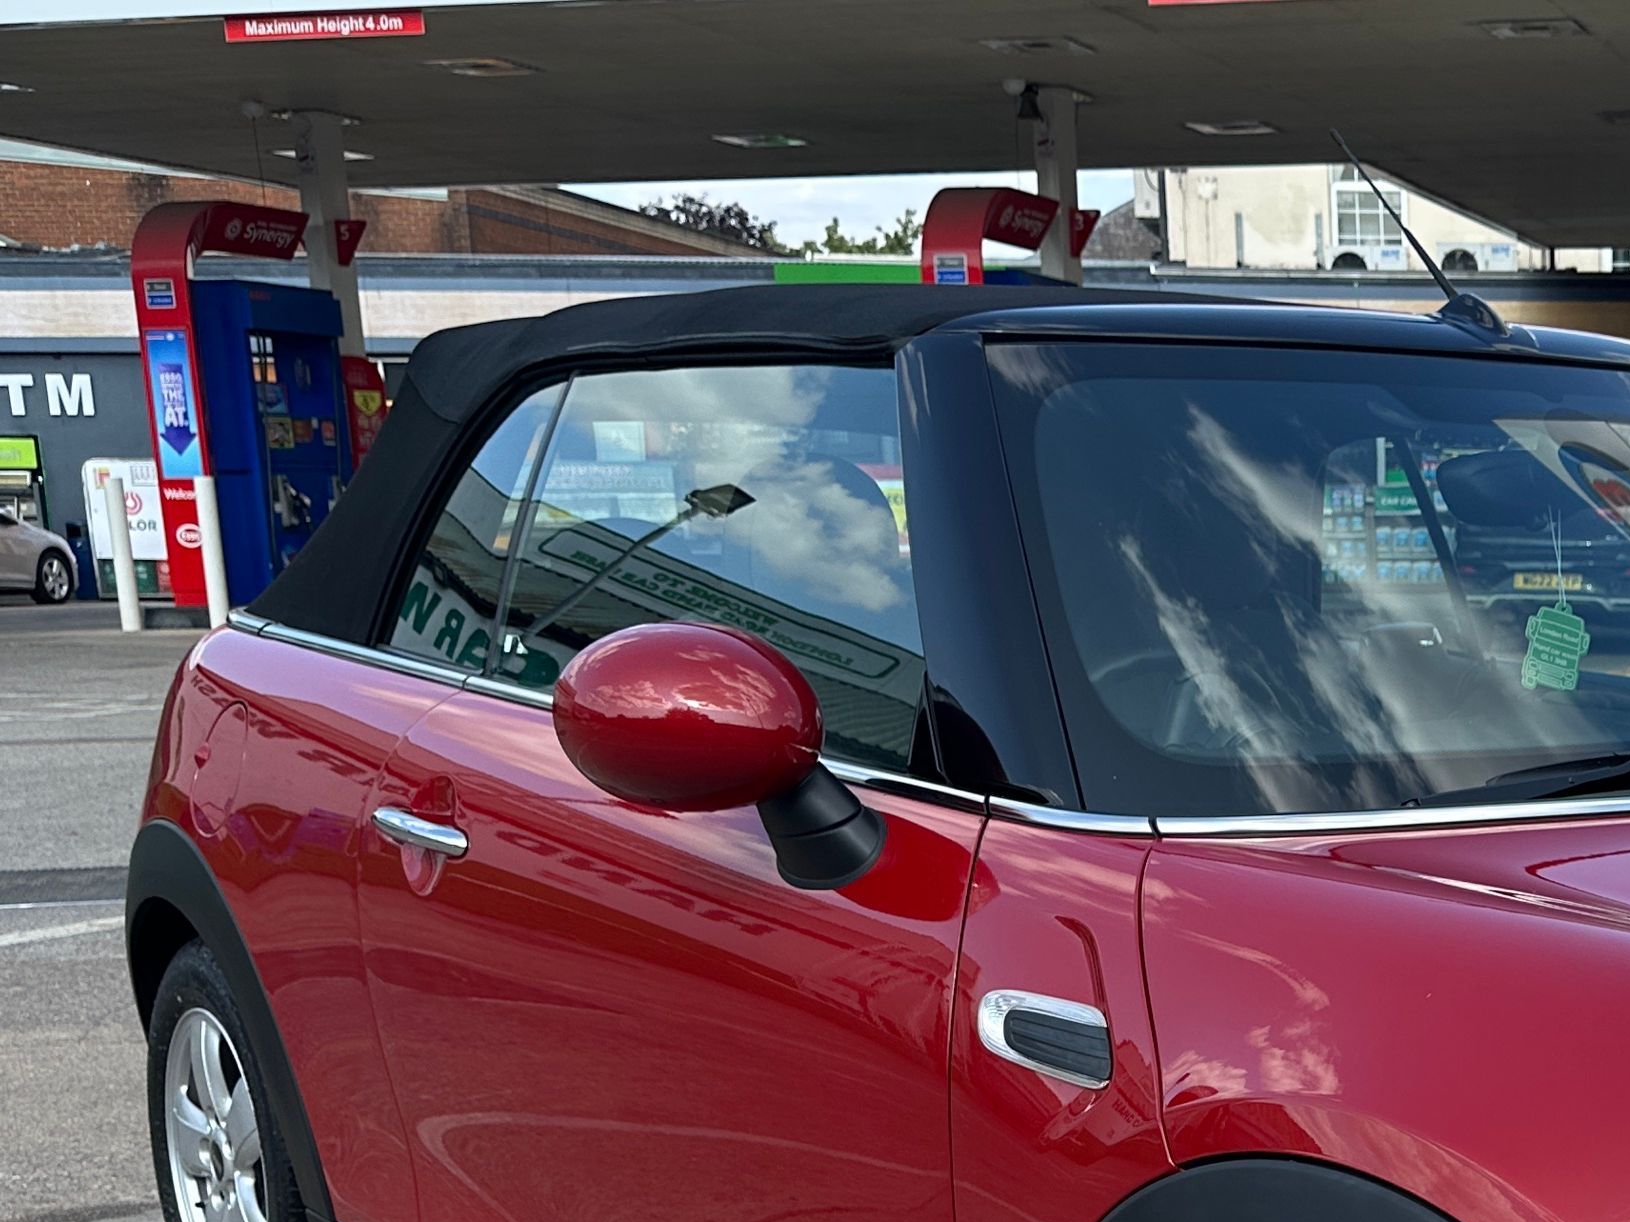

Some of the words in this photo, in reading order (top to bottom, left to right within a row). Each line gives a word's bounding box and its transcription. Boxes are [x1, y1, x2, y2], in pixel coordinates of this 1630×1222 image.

[245, 19, 313, 36] Maximum
[317, 16, 363, 36] Height
[365, 14, 403, 30] 4.0m
[1074, 212, 1085, 231] 3
[244, 222, 295, 248] Synergy
[340, 225, 350, 241] 5
[0, 374, 95, 416] TM
[1540, 626, 1562, 638] London
[1563, 633, 1579, 643] Road
